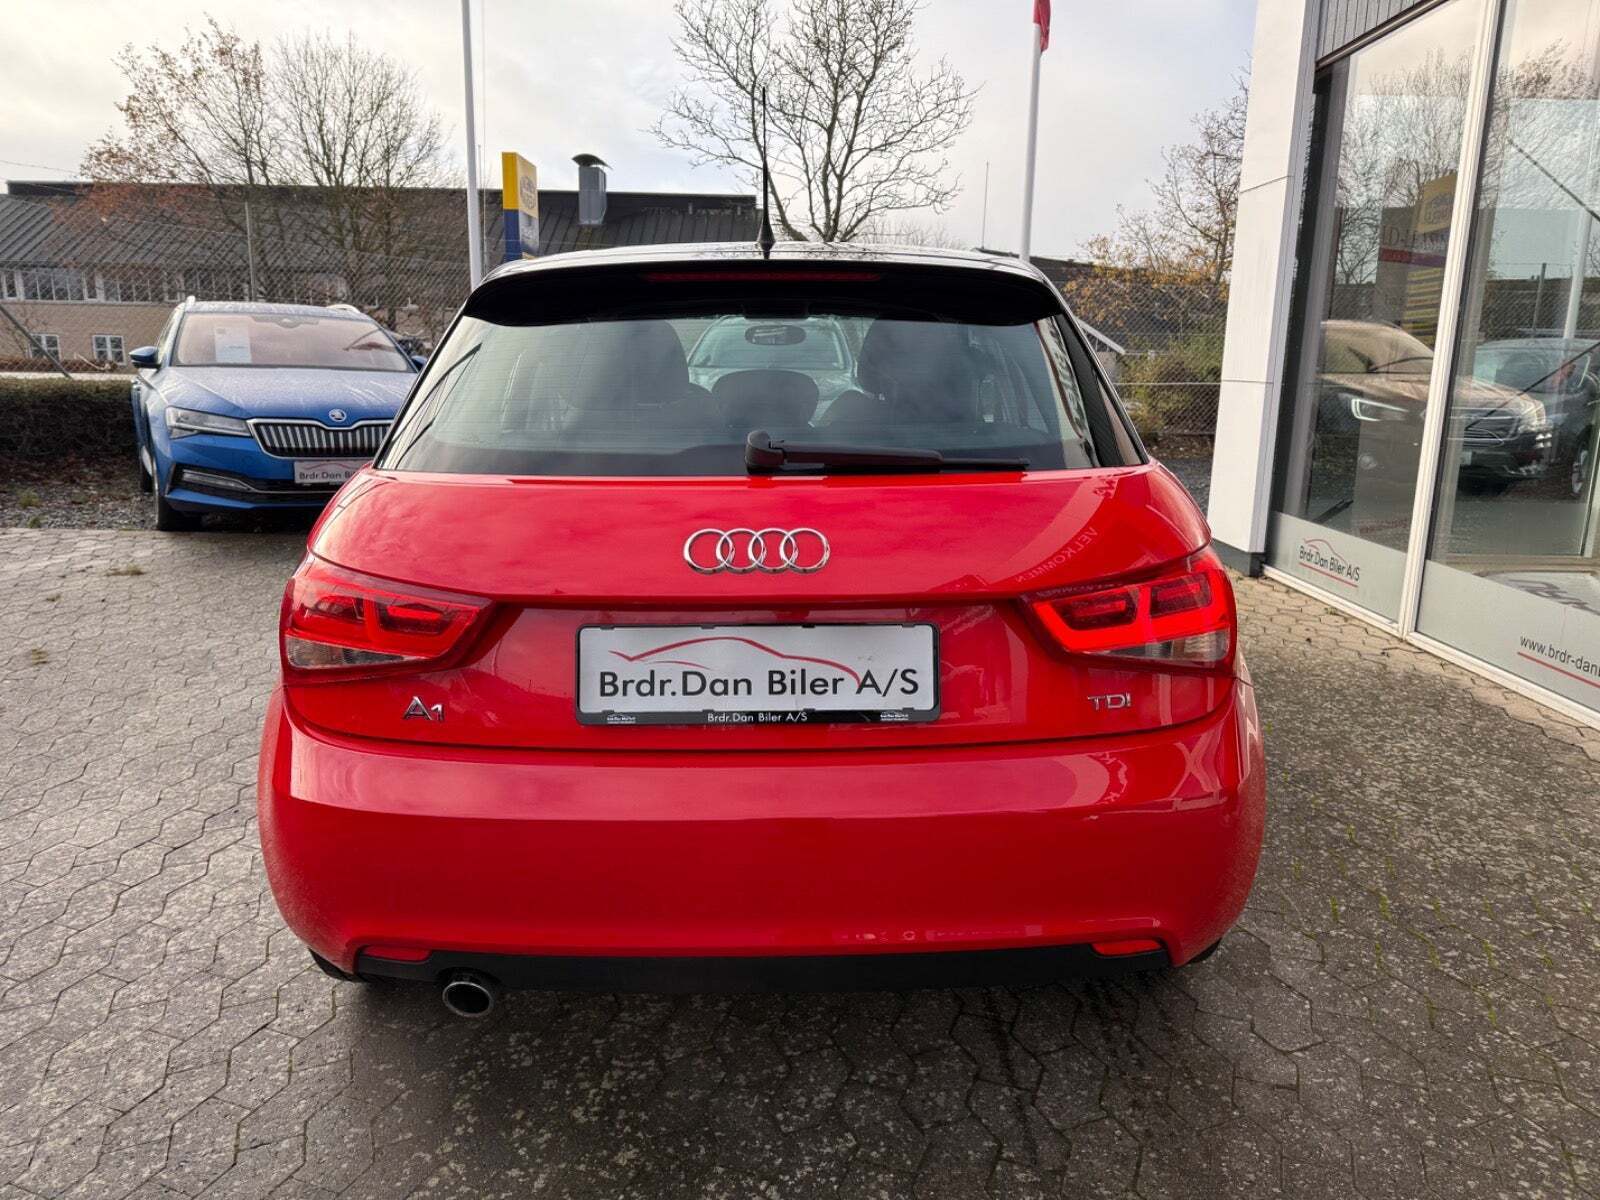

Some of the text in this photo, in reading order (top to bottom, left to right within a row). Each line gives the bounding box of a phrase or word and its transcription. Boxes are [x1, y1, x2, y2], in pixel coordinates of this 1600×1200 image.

[1346, 564, 1360, 581] A/S
[600, 668, 919, 697] Brdr.Dan Biler A/S
[403, 695, 444, 721] A1
[1087, 692, 1131, 711] TDI
[758, 712, 782, 722] Biler
[785, 711, 808, 723] A/S
